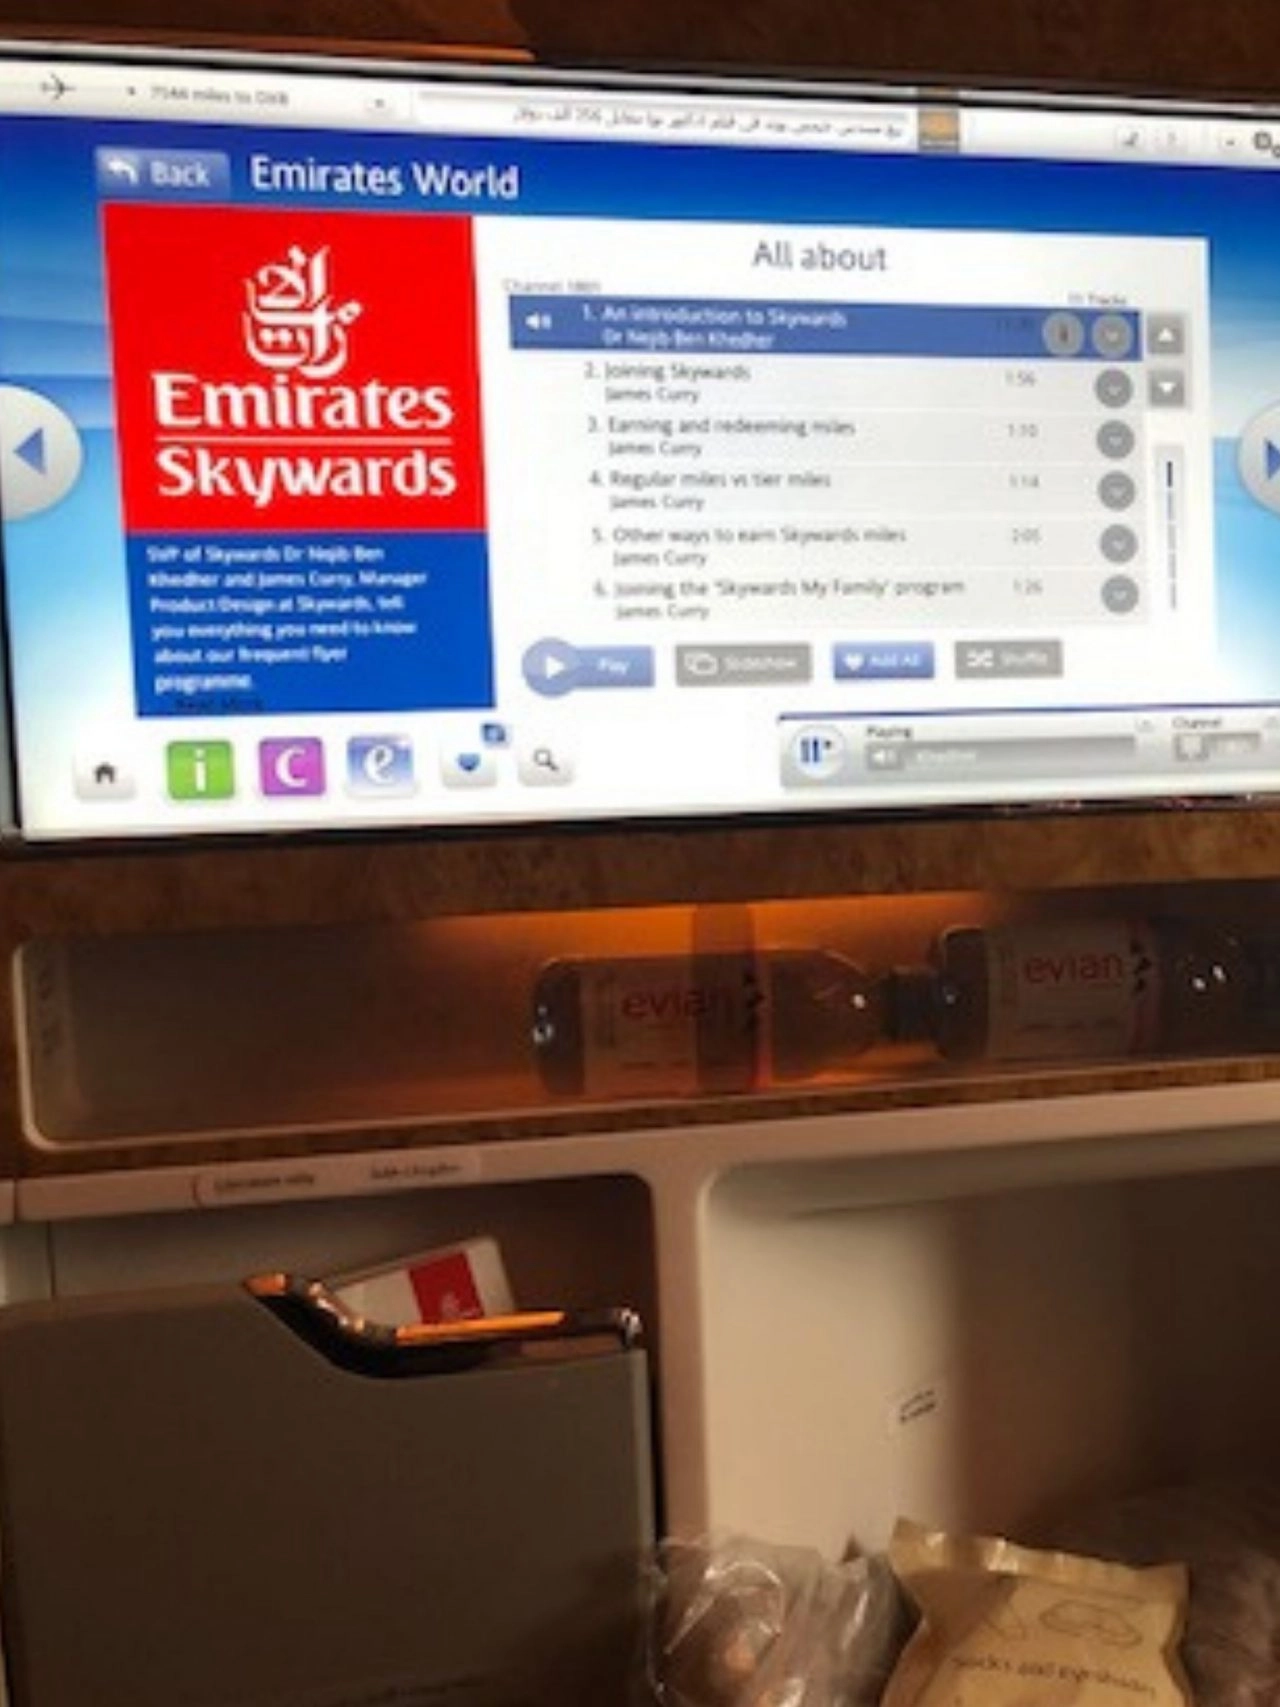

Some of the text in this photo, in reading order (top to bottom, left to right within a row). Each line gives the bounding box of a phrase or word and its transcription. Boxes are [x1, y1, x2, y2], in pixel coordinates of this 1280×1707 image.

[150, 160, 209, 188] Back
[250, 156, 518, 200] Emirates World
[753, 240, 887, 272] All about
[603, 305, 626, 321] An
[632, 304, 742, 324] introduction
[747, 306, 763, 324] to
[766, 308, 848, 329] Skywards
[605, 363, 664, 383] Joining
[671, 364, 750, 383] Skywards
[152, 373, 453, 430] Emirates
[605, 386, 699, 404] James Curry
[609, 417, 672, 436] Earning
[679, 415, 709, 433] and
[715, 416, 806, 438] redeeming
[812, 418, 855, 434] miles
[609, 440, 702, 458] James Curry
[156, 447, 457, 507] Skywards
[610, 470, 676, 491] Regular
[681, 470, 727, 488] miles
[753, 471, 782, 488] tier
[788, 471, 831, 488] miles
[609, 494, 704, 512] James Curry
[613, 527, 663, 543] Other
[668, 529, 710, 548] ways
[716, 528, 733, 543] to
[738, 530, 777, 543] earn
[781, 527, 859, 547] Skywards
[863, 527, 906, 543] miles
[613, 550, 707, 569] James Curry
[614, 580, 675, 600] Joining
[680, 579, 708, 596] the
[801, 580, 827, 598] My
[895, 580, 966, 598] program
[616, 603, 710, 621] James Curry
[1024, 950, 1123, 985] evian
